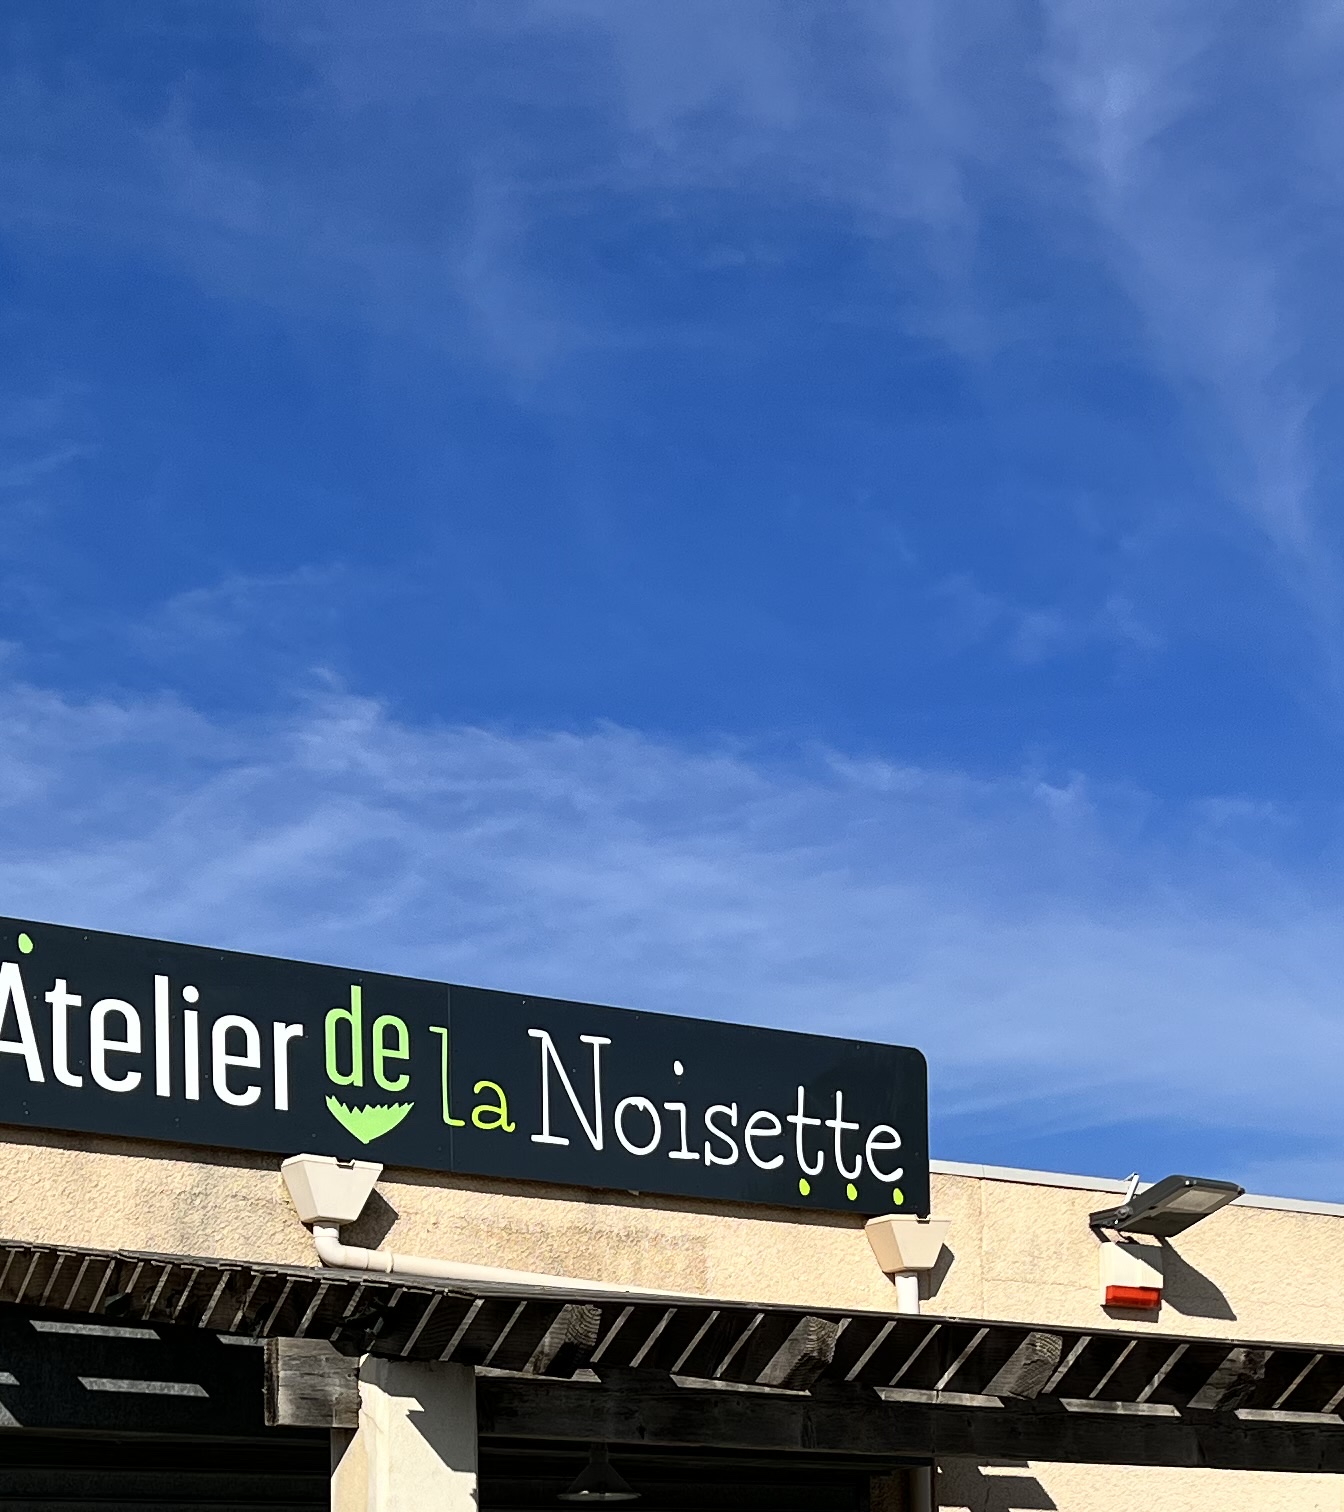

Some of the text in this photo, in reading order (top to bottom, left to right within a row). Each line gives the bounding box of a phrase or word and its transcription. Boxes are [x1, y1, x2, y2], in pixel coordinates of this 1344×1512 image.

[325, 985, 409, 1091] de
[429, 1026, 515, 1132] la
[528, 1029, 903, 1182] Noisette
